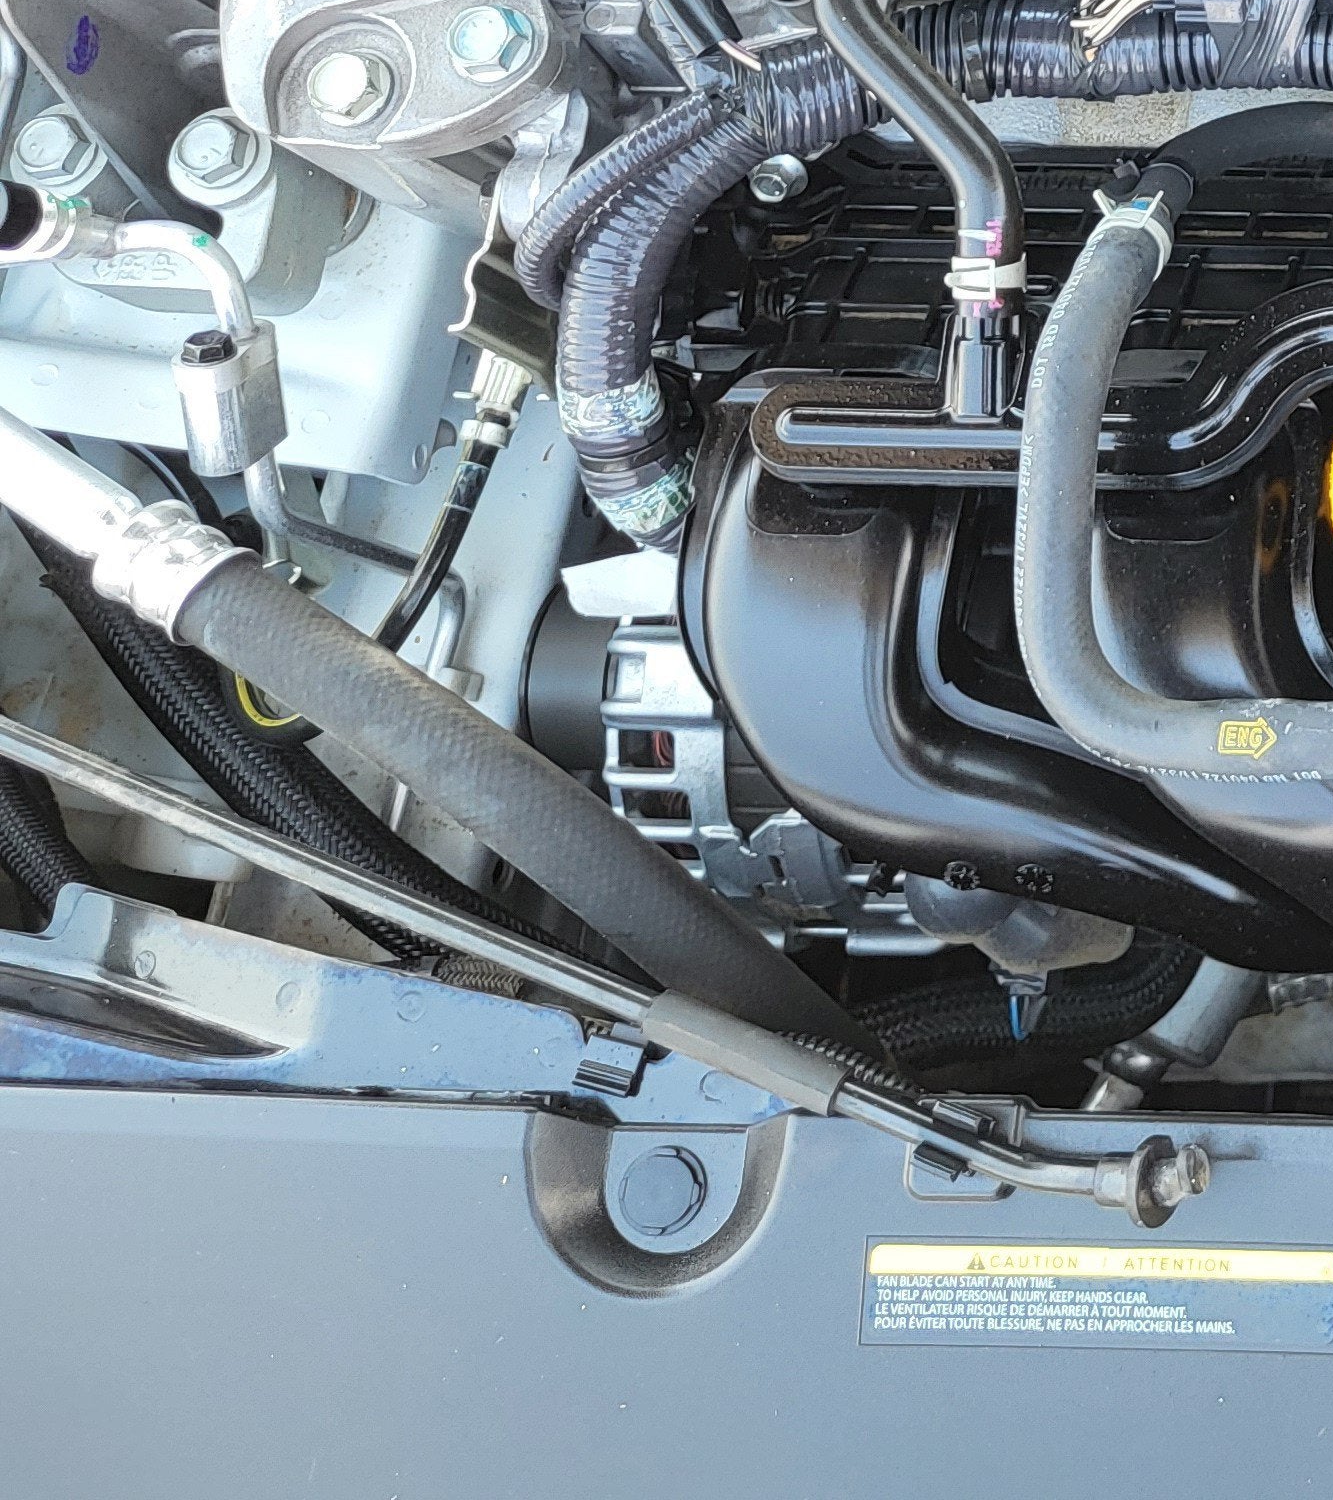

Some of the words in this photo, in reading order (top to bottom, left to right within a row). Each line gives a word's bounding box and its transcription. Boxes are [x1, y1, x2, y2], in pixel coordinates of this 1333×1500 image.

[1030, 356, 1050, 389] DOT
[1224, 726, 1263, 748] ENG
[990, 1255, 1078, 1269] CAUTION
[1124, 1258, 1230, 1271] ATTENTION
[878, 1276, 898, 1287] FAN
[900, 1276, 933, 1287] BLADE
[935, 1276, 958, 1287] CAN
[960, 1277, 990, 1288] START
[992, 1277, 1006, 1288] AT
[1006, 1277, 1030, 1288] ANY
[1030, 1277, 1056, 1288] TIME.
[877, 1289, 891, 1301] TO
[894, 1289, 919, 1301] HELP
[922, 1289, 954, 1301] AVOID
[956, 1290, 1008, 1302] PERSONAL
[1049, 1291, 1074, 1302] KEEP
[1076, 1291, 1112, 1303] HANDS
[1114, 1292, 1148, 1304] CLEAR.
[875, 1303, 889, 1315] LE
[891, 1303, 964, 1315] VENTILATEUR
[966, 1304, 1007, 1317] RISQUE
[1009, 1304, 1025, 1316] DE
[1028, 1302, 1088, 1316] DÉMARRER
[1101, 1305, 1132, 1317] TOUT
[1134, 1306, 1187, 1319] MOMENT.
[875, 1317, 906, 1329] POUR
[909, 1315, 946, 1329] ÉVITER
[949, 1318, 984, 1329] TOUTE
[1047, 1319, 1062, 1331] NE
[1065, 1319, 1085, 1331] PAS
[1088, 1320, 1103, 1331] EN
[1105, 1320, 1172, 1332] APPROCHER
[1174, 1320, 1193, 1332] LES
[1196, 1321, 1235, 1334] MAINS.
